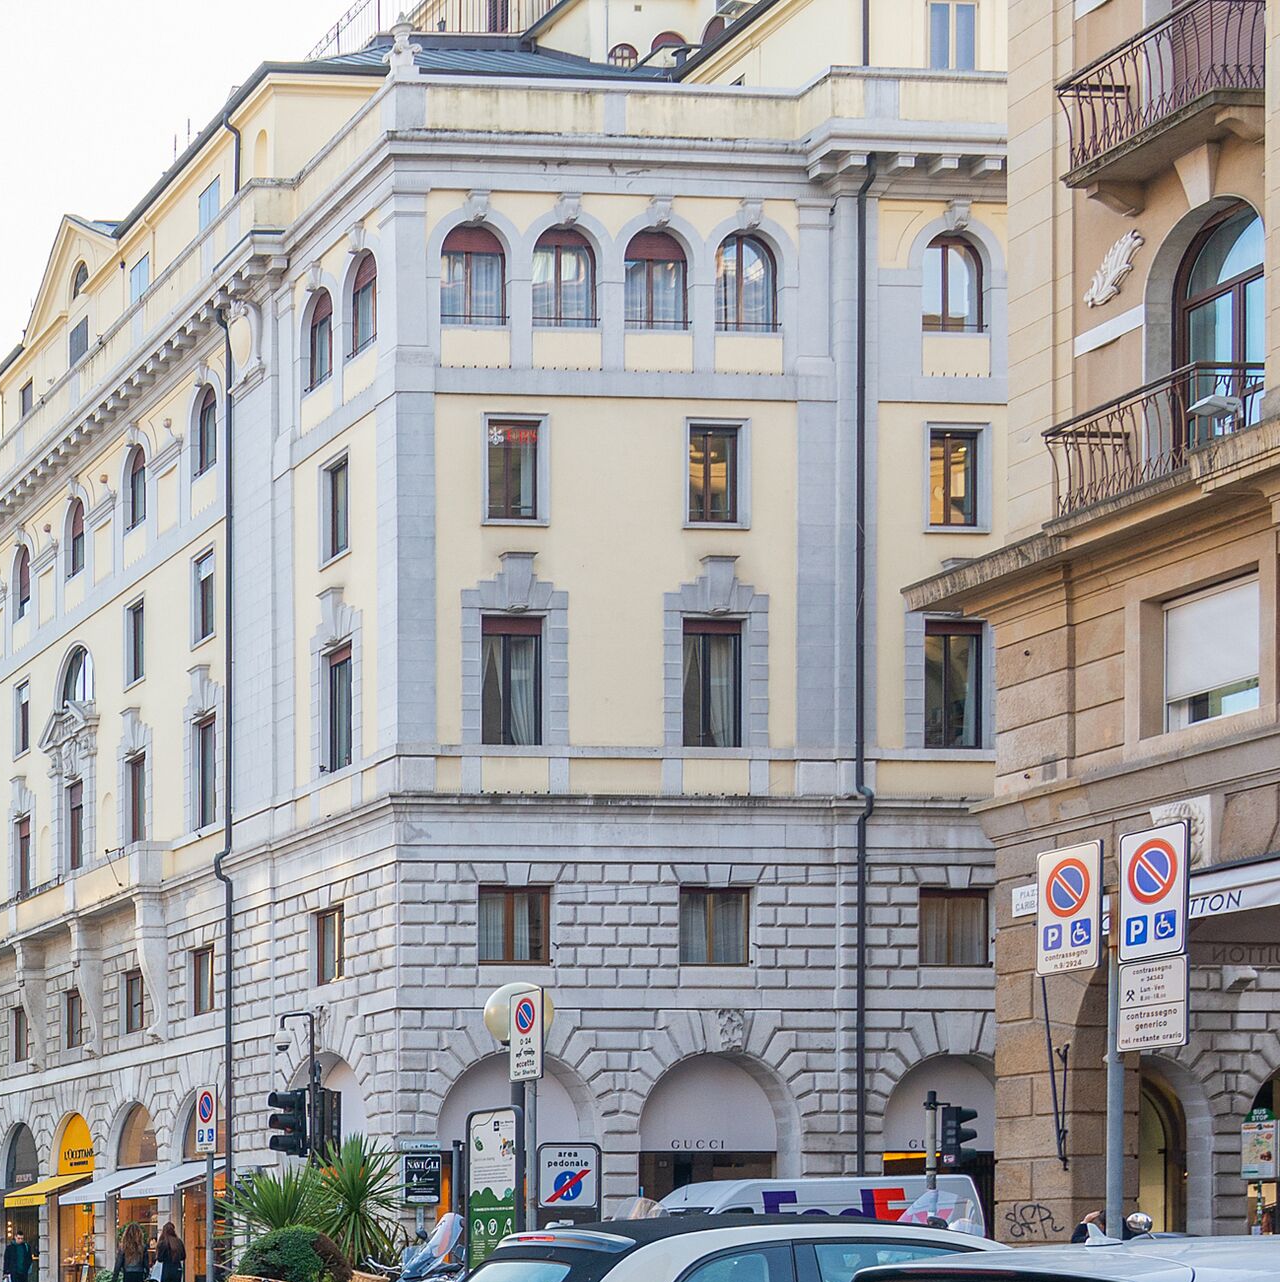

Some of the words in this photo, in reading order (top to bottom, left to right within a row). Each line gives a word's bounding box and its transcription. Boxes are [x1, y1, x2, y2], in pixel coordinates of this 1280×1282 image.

[1044, 949, 1088, 962] contrassegno
[1126, 1008, 1178, 1020] contrassegno
[1134, 1020, 1168, 1032] generico
[1132, 1034, 1160, 1044] restante
[670, 1139, 725, 1150] GUCCI
[547, 1159, 589, 1169] pedonale
